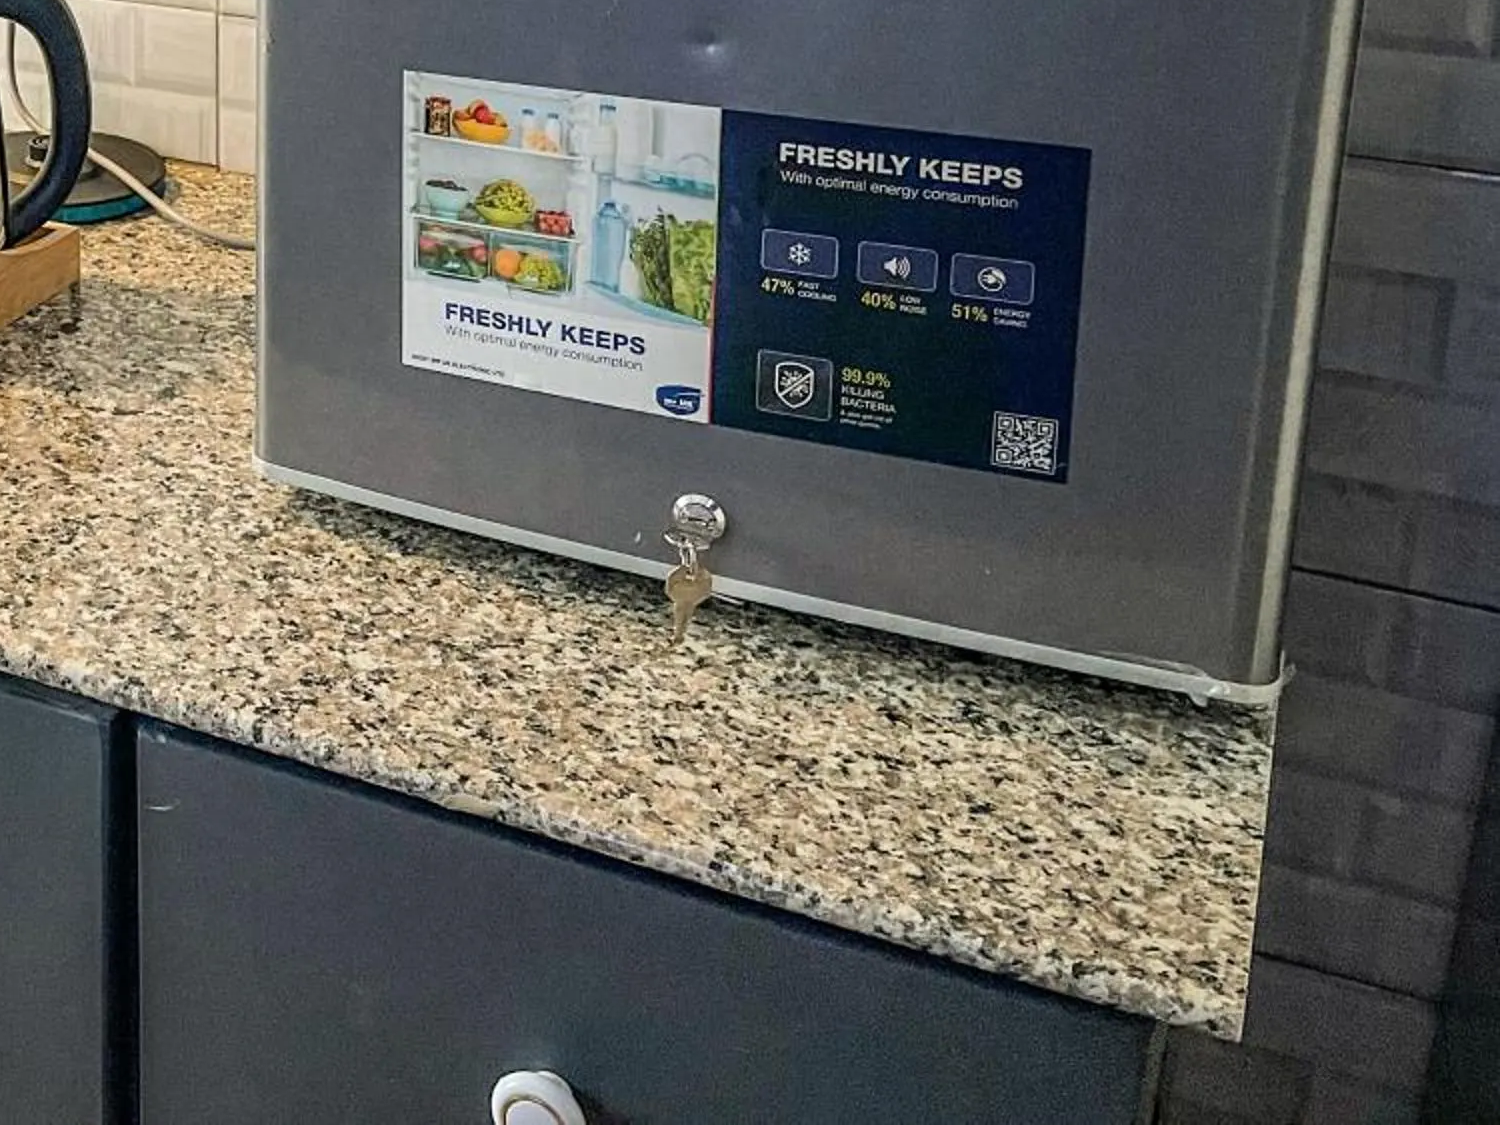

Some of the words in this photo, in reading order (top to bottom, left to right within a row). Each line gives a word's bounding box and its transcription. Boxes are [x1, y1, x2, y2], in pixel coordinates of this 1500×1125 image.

[779, 142, 911, 176] FRESHLY
[918, 158, 1023, 189] KEEPS
[780, 170, 813, 185] With
[815, 175, 867, 193] optimal
[870, 184, 920, 200] energy
[922, 188, 1019, 210] consumption
[761, 277, 795, 296] 47%
[861, 290, 896, 310] 40%
[951, 303, 988, 322] 51%
[445, 302, 553, 338] FRESHLY
[560, 324, 646, 355] KEEPS
[445, 326, 471, 339] With
[519, 341, 560, 358] energy
[562, 349, 643, 372] consumption
[841, 367, 891, 389] 99.9%
